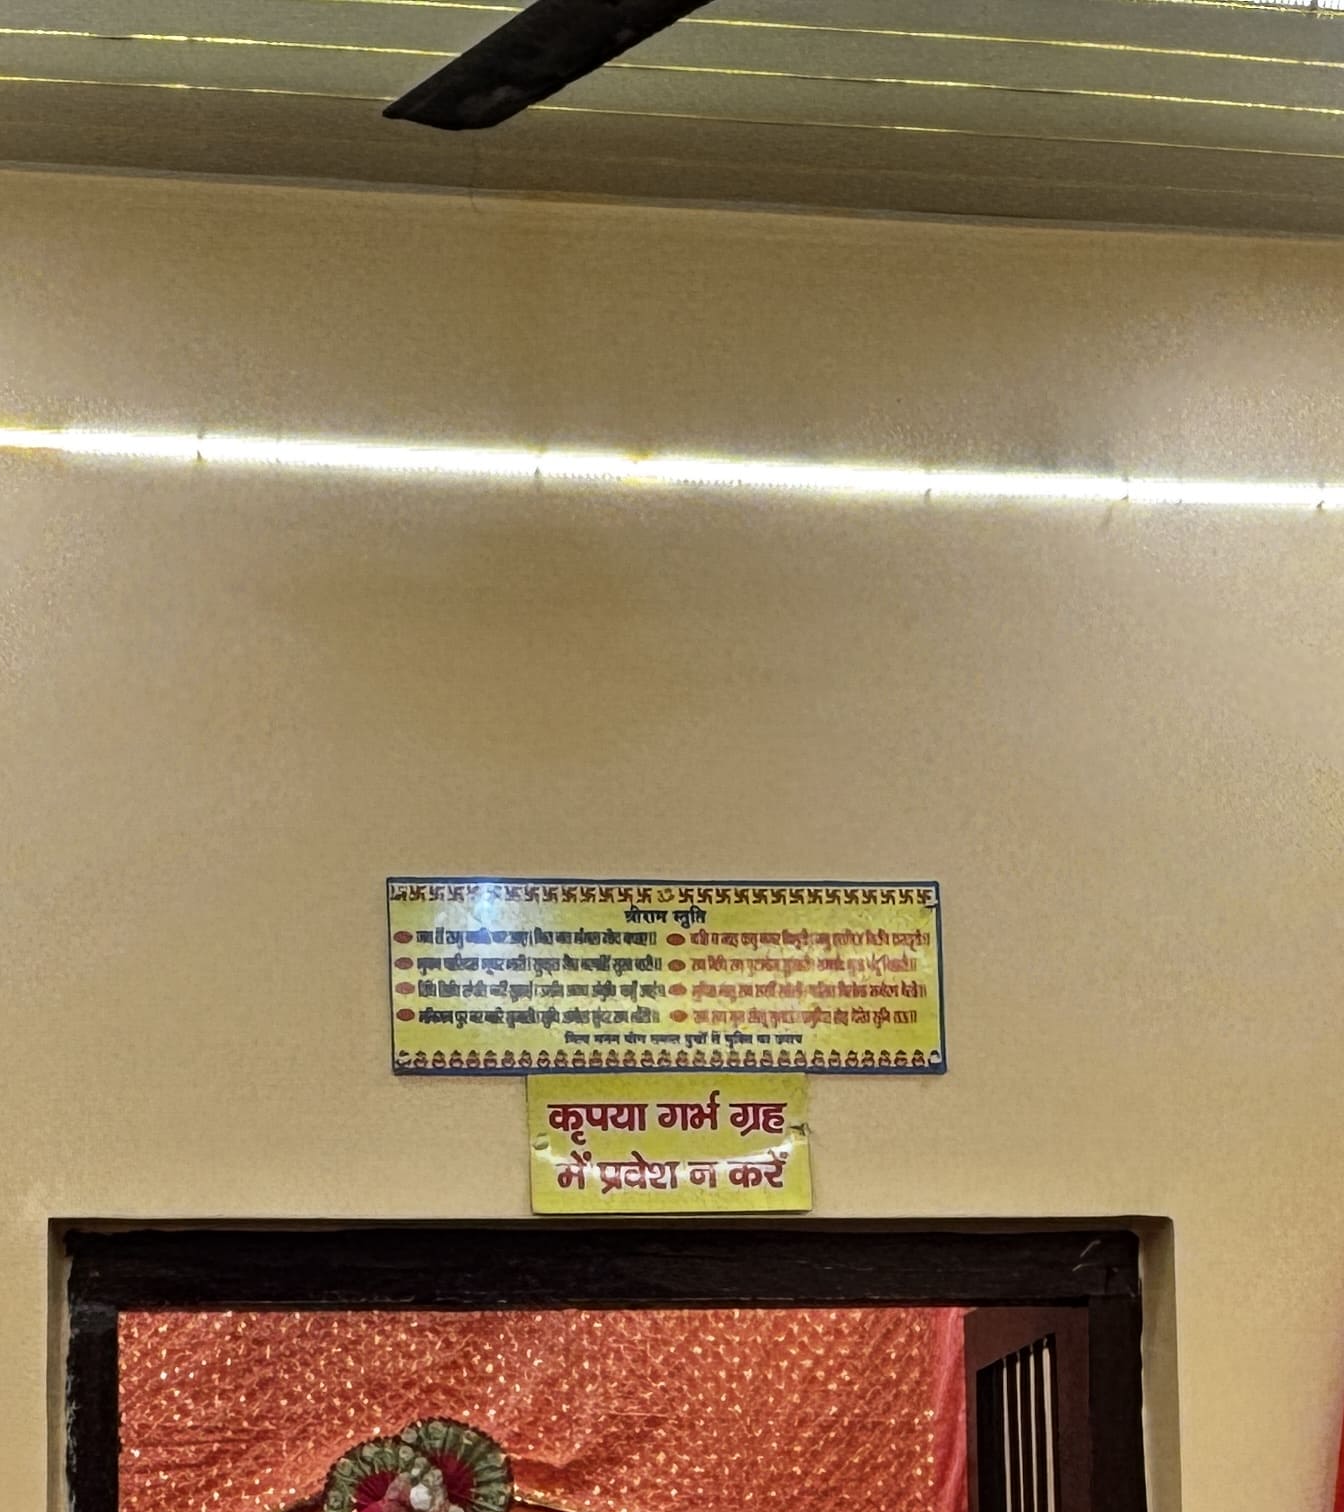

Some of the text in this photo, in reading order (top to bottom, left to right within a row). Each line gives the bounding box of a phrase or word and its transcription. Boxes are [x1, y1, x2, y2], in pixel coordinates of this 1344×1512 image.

[548, 1090, 787, 1145] कृपया गर्भ ग्रह
[556, 1149, 788, 1194] में प्रवेश न करें
